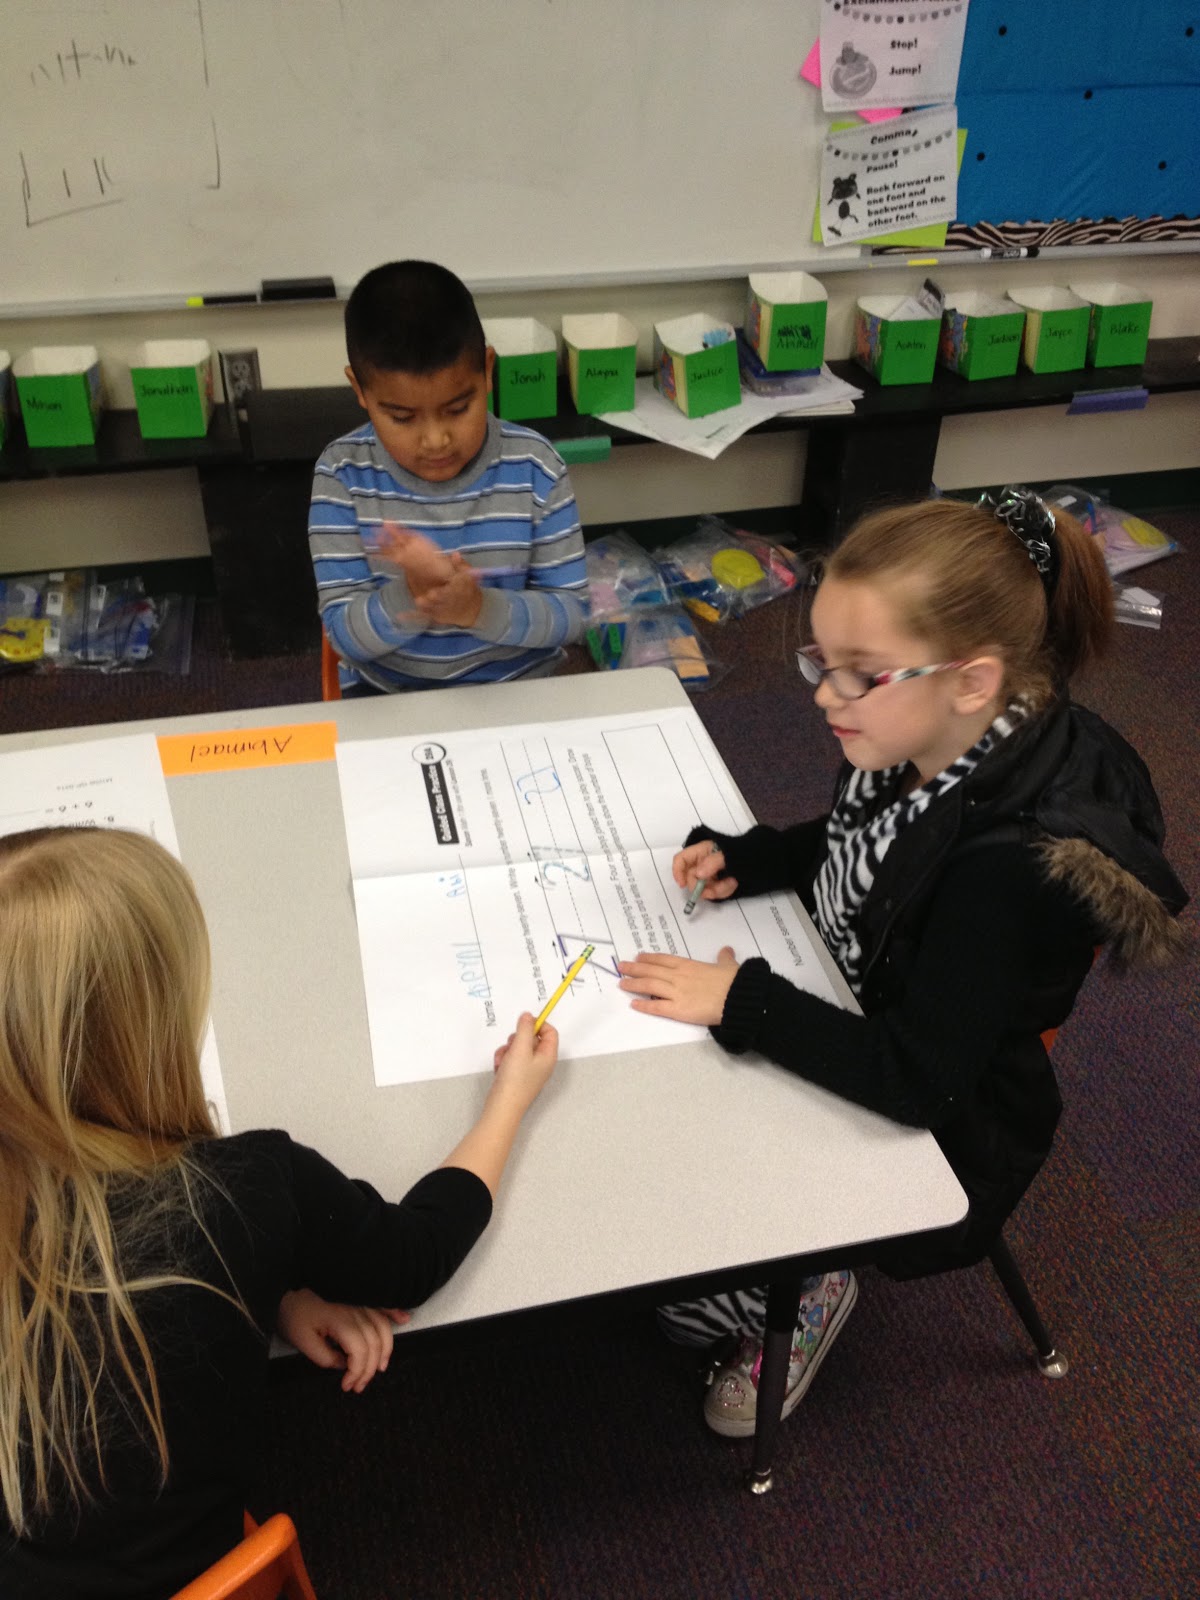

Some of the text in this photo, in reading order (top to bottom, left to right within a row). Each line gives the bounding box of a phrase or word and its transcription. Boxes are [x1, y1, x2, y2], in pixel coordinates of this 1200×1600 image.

[890, 37, 918, 50] Stop!
[889, 63, 922, 75] Jump!
[870, 129, 918, 145] Comma,
[866, 159, 898, 174] Pause!
[866, 184, 890, 195] Rock
[892, 175, 931, 190] forward
[867, 187, 926, 206] one foot and
[867, 200, 914, 217] backward
[930, 195, 946, 204] the
[868, 217, 893, 227] other
[1044, 327, 1073, 340] Jayce
[1109, 322, 1140, 336] Blake
[510, 368, 546, 385] Jonah
[190, 735, 292, 762] Abimael
[564, 747, 576, 764] Draw
[427, 764, 441, 794] Practice
[588, 772, 602, 794] number
[577, 782, 589, 796] play
[432, 793, 446, 814] Class
[596, 794, 605, 804] the
[584, 801, 595, 817] them
[600, 803, 611, 820] show
[437, 814, 452, 842] Guided
[589, 816, 604, 836] joined
[506, 867, 518, 888] Write
[605, 863, 619, 881] Four
[629, 883, 641, 899] write
[635, 898, 646, 913] and
[622, 904, 638, 931] playing
[640, 912, 654, 931] boys
[631, 930, 643, 949] were
[646, 930, 657, 943] the
[662, 930, 678, 955] soccer
[769, 903, 804, 967] Number sentence
[524, 937, 538, 965] number
[650, 942, 660, 953] of
[531, 966, 541, 978] the
[534, 979, 547, 1001] Trace
[484, 1000, 497, 1027] Name
